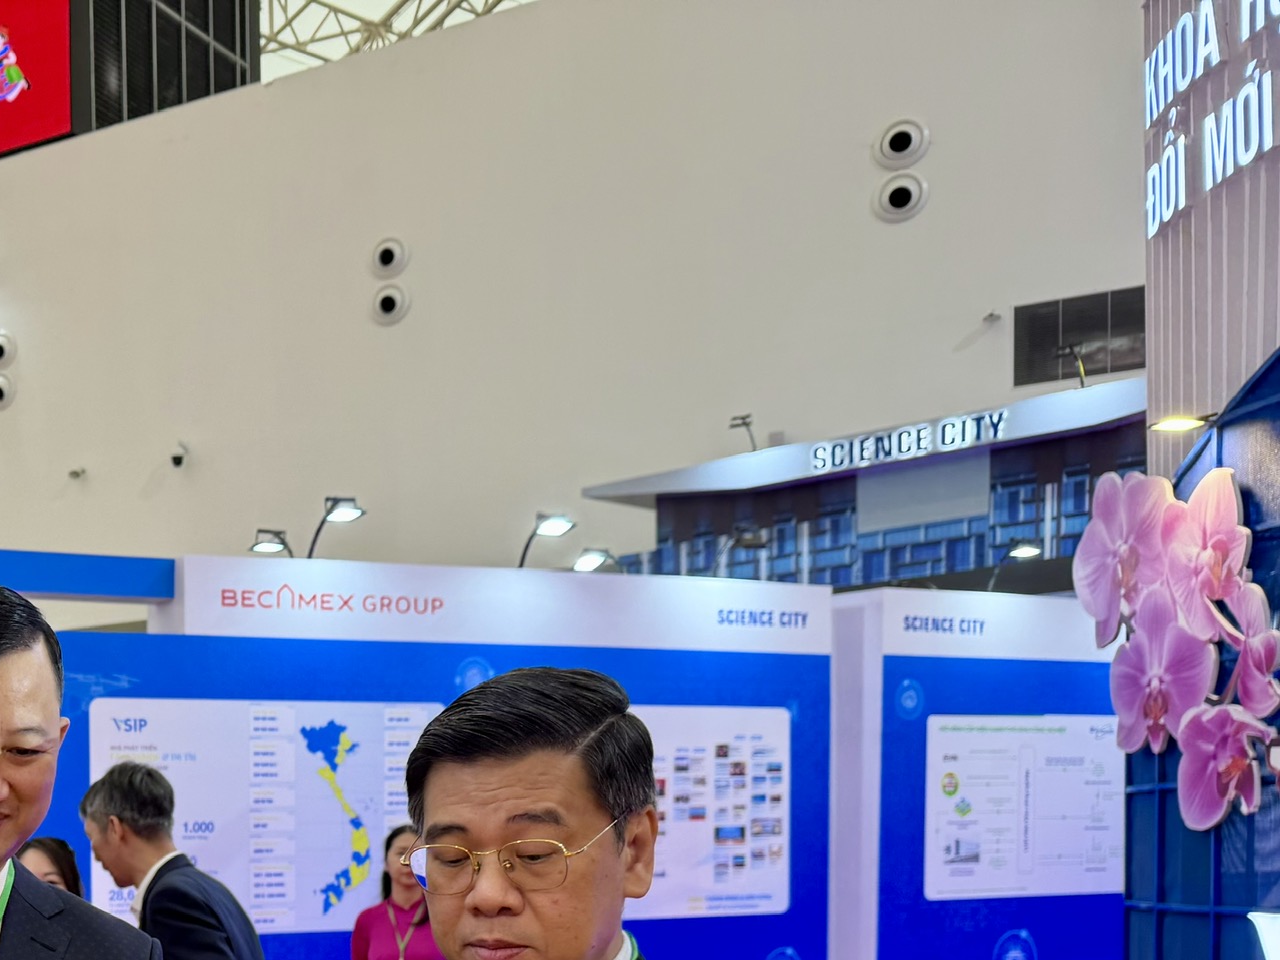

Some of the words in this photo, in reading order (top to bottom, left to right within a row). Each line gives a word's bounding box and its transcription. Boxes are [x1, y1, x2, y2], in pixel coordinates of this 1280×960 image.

[1144, 0, 1220, 130] KHOA
[1146, 106, 1186, 240] ĐỔI
[1203, 58, 1272, 192] MỚI
[811, 422, 930, 473] SCIENCE
[940, 410, 1008, 448] CITY
[220, 583, 354, 612] BECAMEX
[362, 594, 444, 615] GROUP
[717, 608, 774, 628] SCIENCE
[778, 610, 808, 630] CITY
[903, 614, 954, 636] SCIENCE
[958, 617, 986, 638] CITY
[112, 718, 148, 732] VSIP
[183, 822, 215, 834] 1.000
